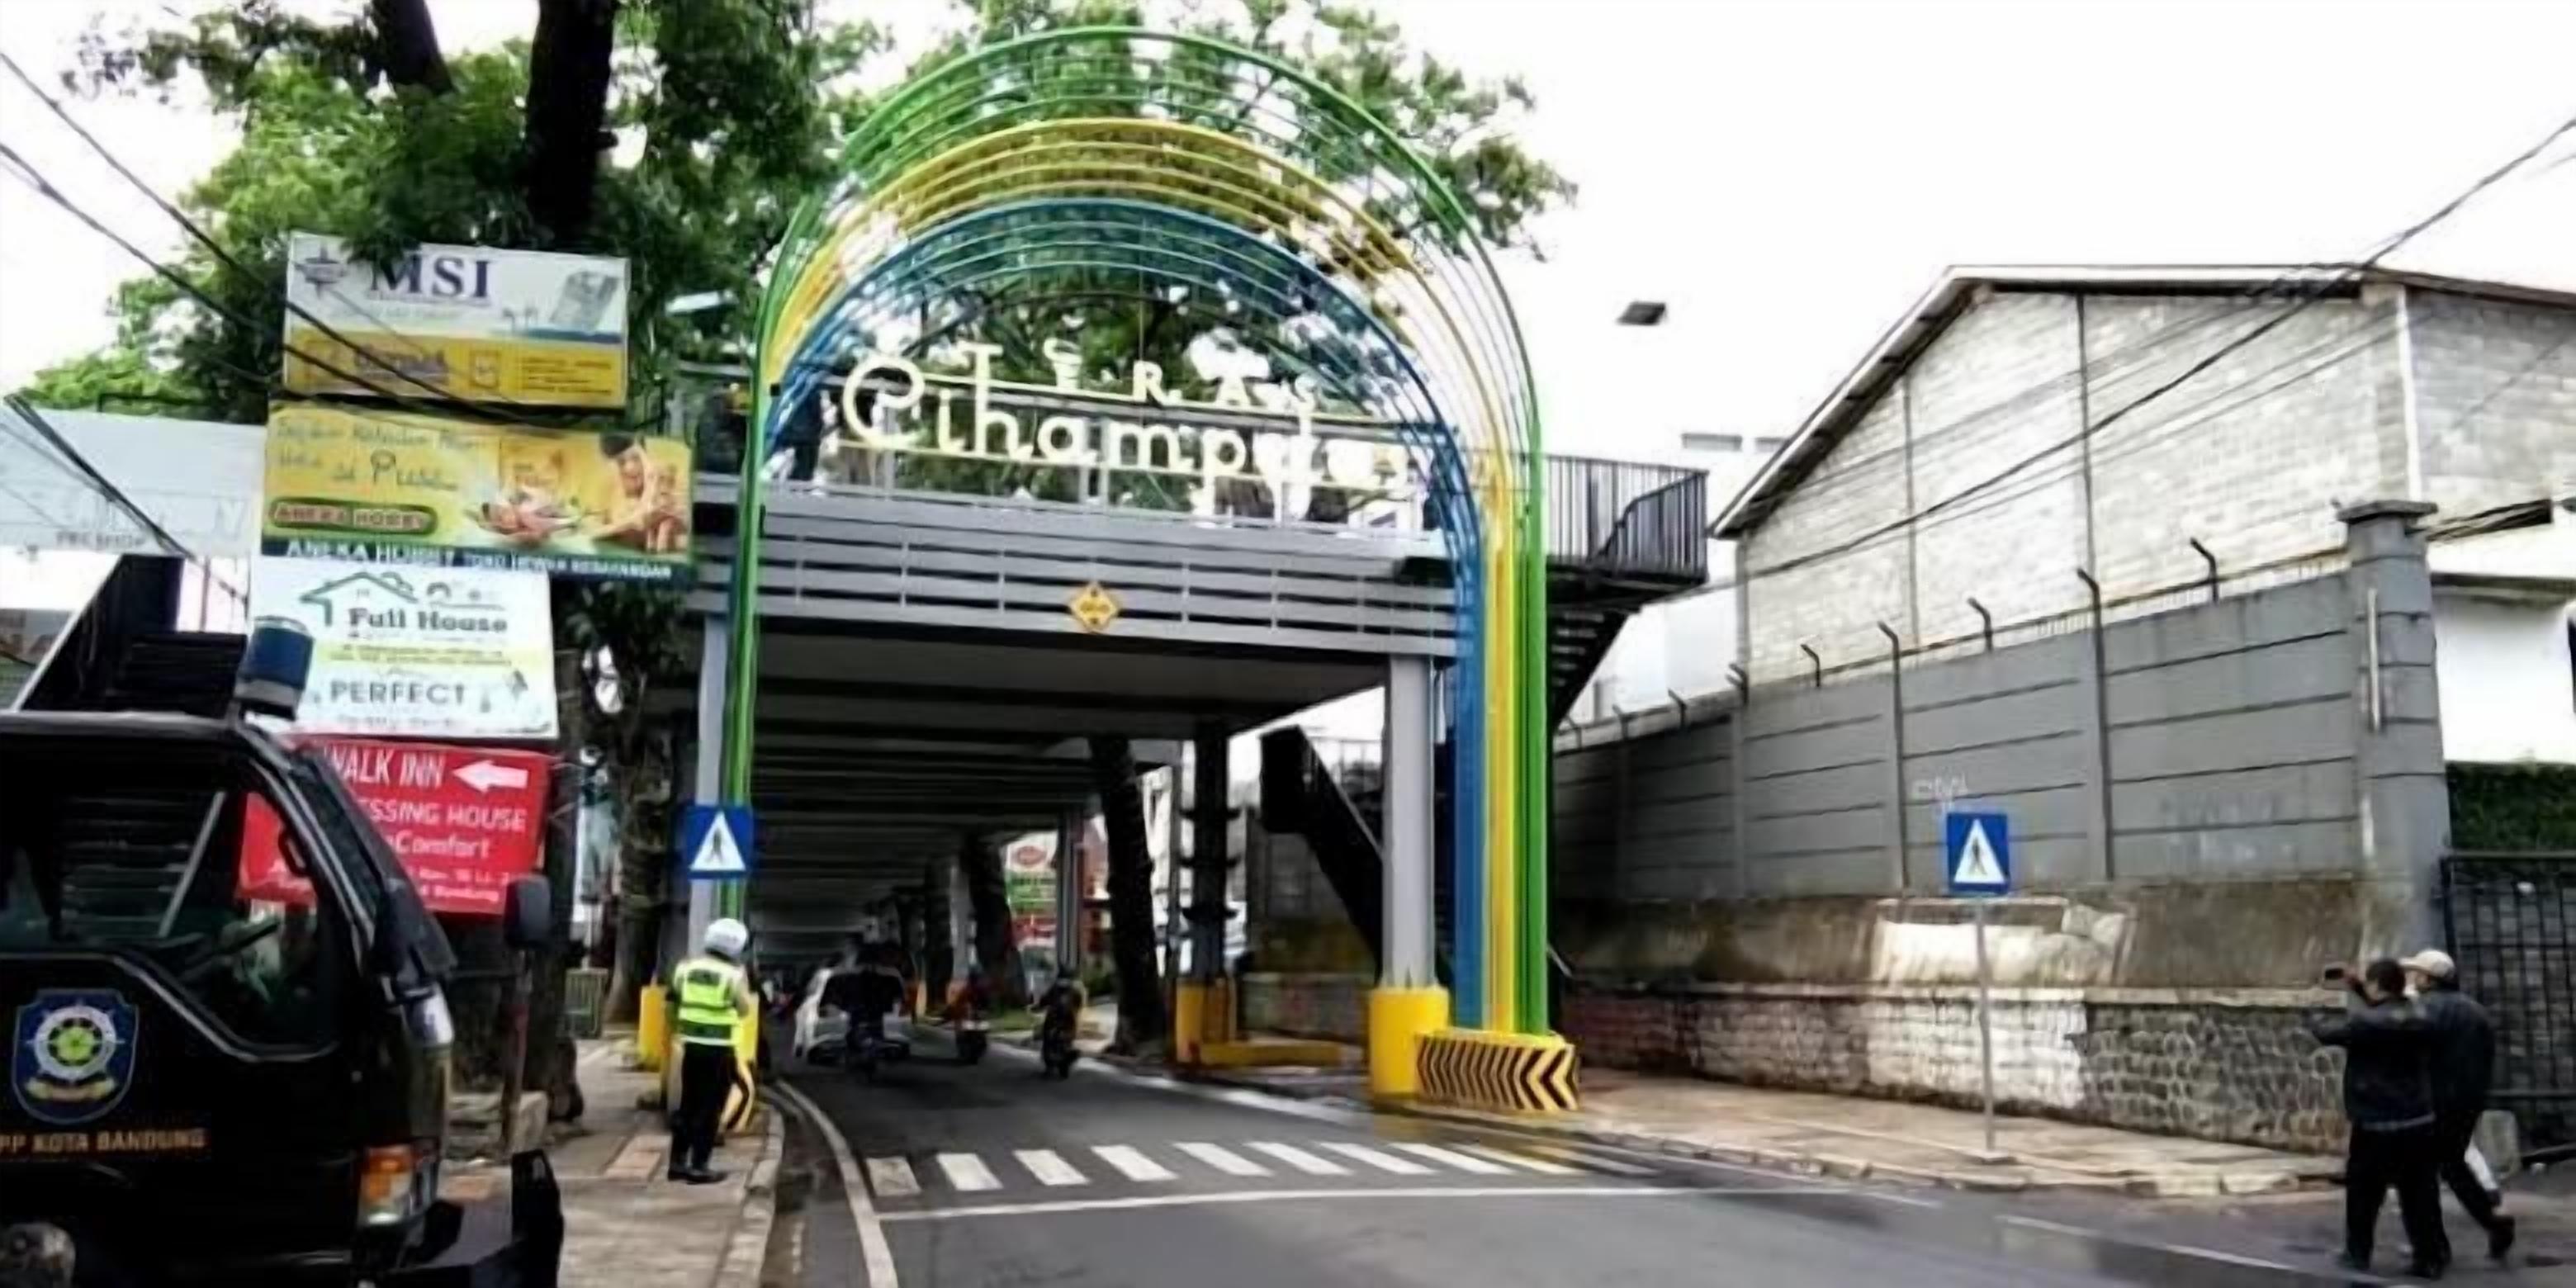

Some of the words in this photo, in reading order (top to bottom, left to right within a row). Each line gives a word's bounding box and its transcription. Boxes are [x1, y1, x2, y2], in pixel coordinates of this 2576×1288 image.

[370, 253, 493, 298] MSI
[348, 608, 406, 629] Full
[417, 611, 508, 632] House
[330, 680, 465, 704] PERFECT
[358, 798, 441, 825] SSING
[447, 804, 528, 831] HOUSE
[32, 1133, 88, 1153] KOTA
[97, 1129, 206, 1151] BANDUNG
